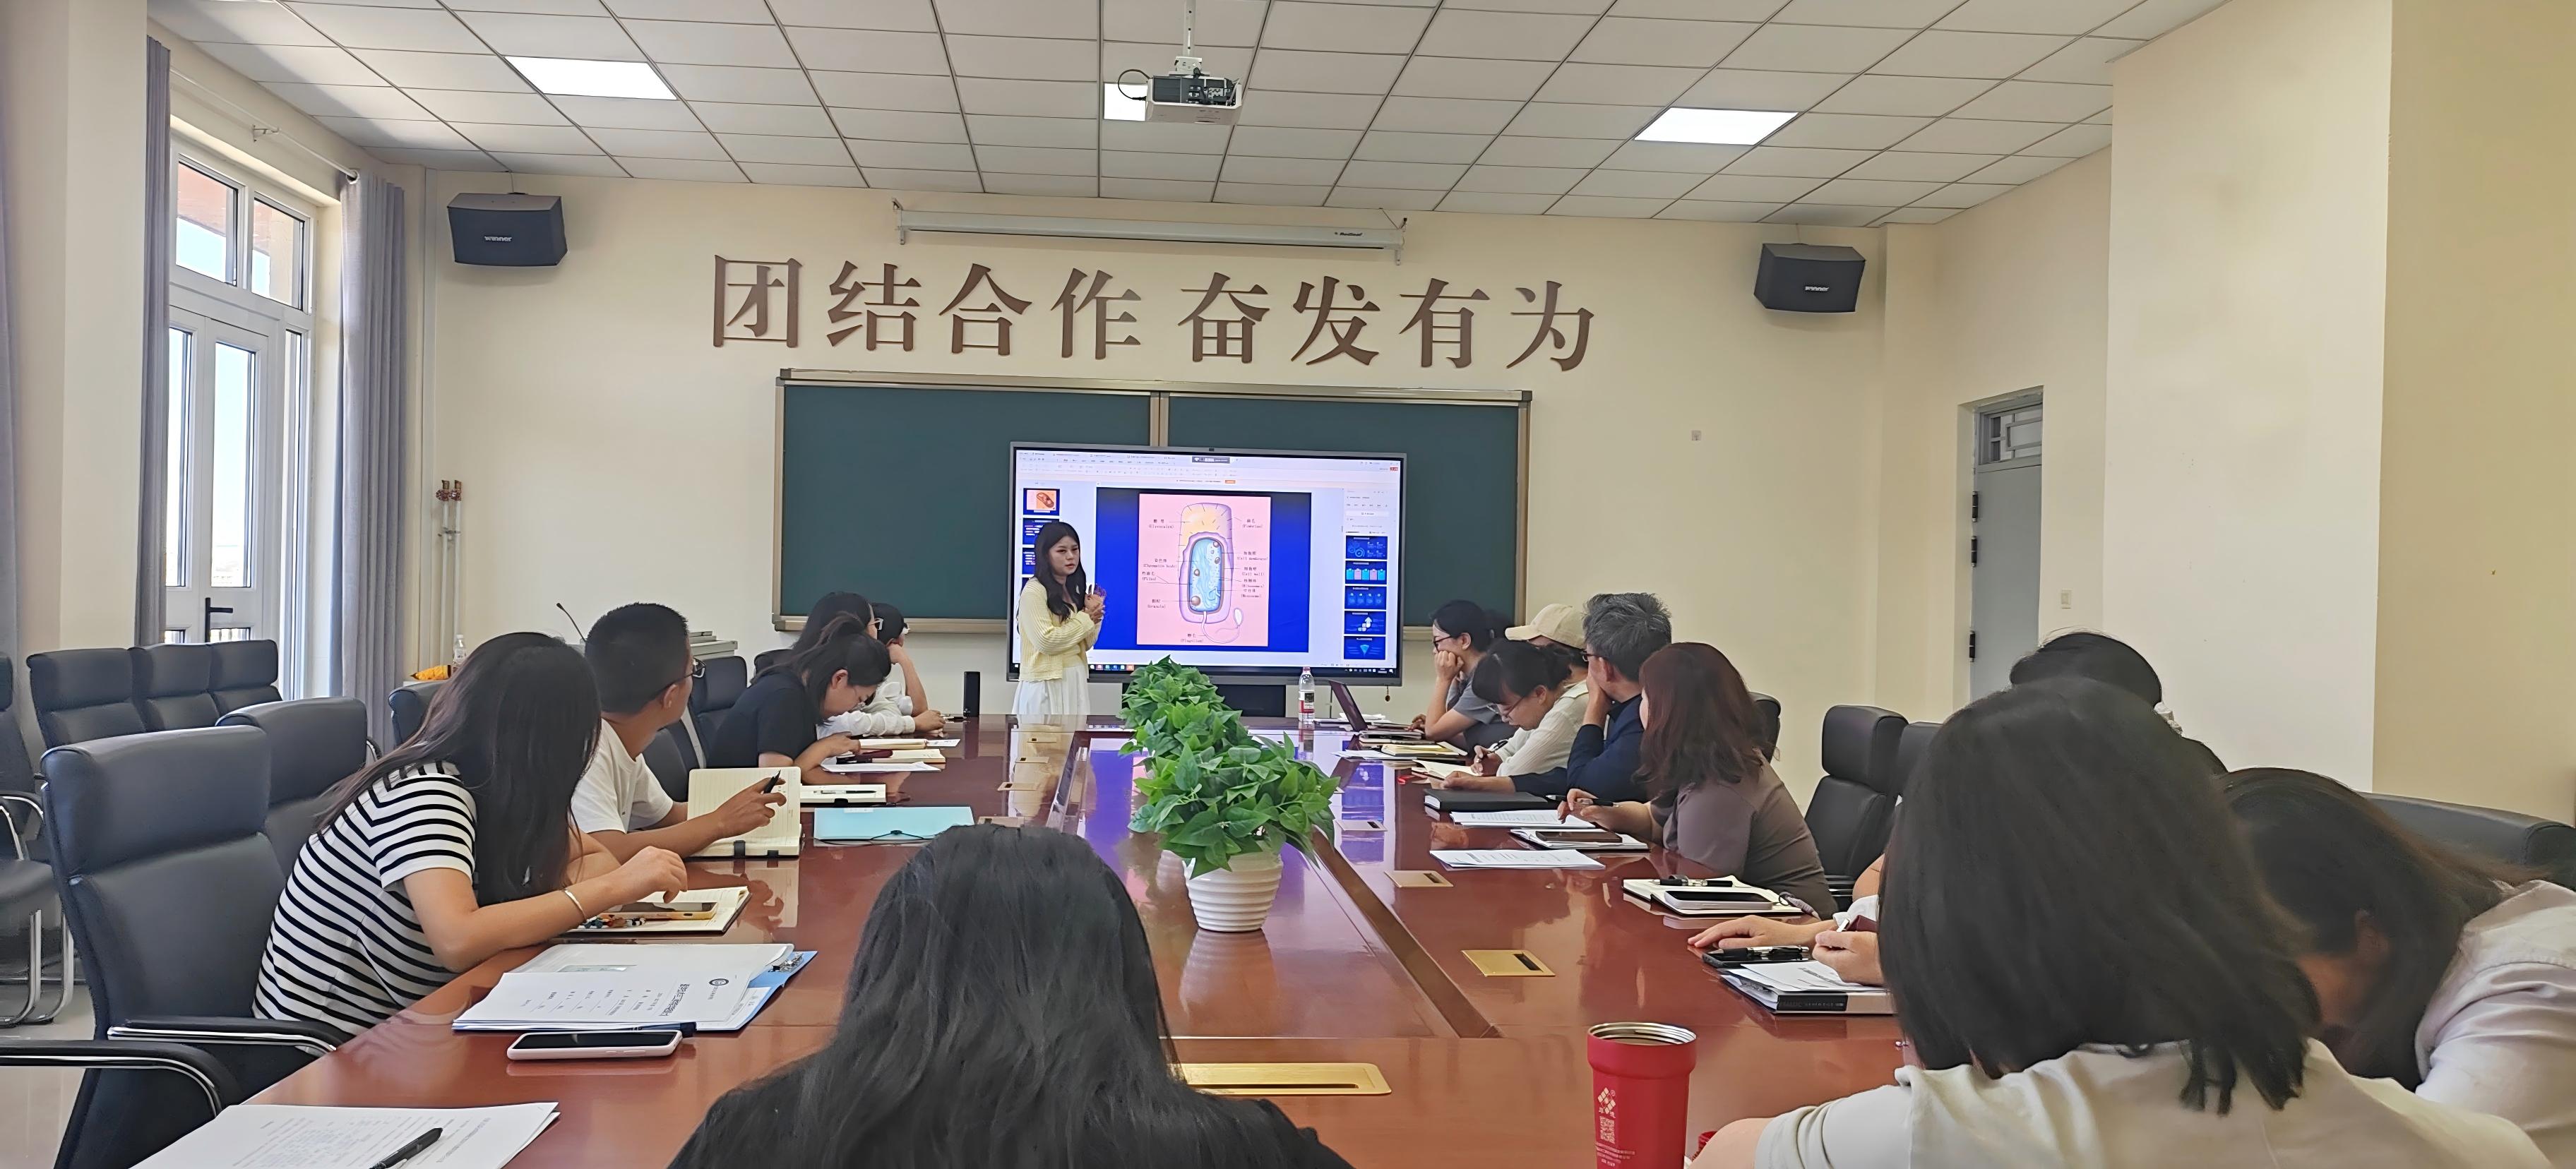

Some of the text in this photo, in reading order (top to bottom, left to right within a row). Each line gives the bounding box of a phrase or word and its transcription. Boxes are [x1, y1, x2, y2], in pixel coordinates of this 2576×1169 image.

[713, 254, 1595, 372] 团结合作 奋发有为
